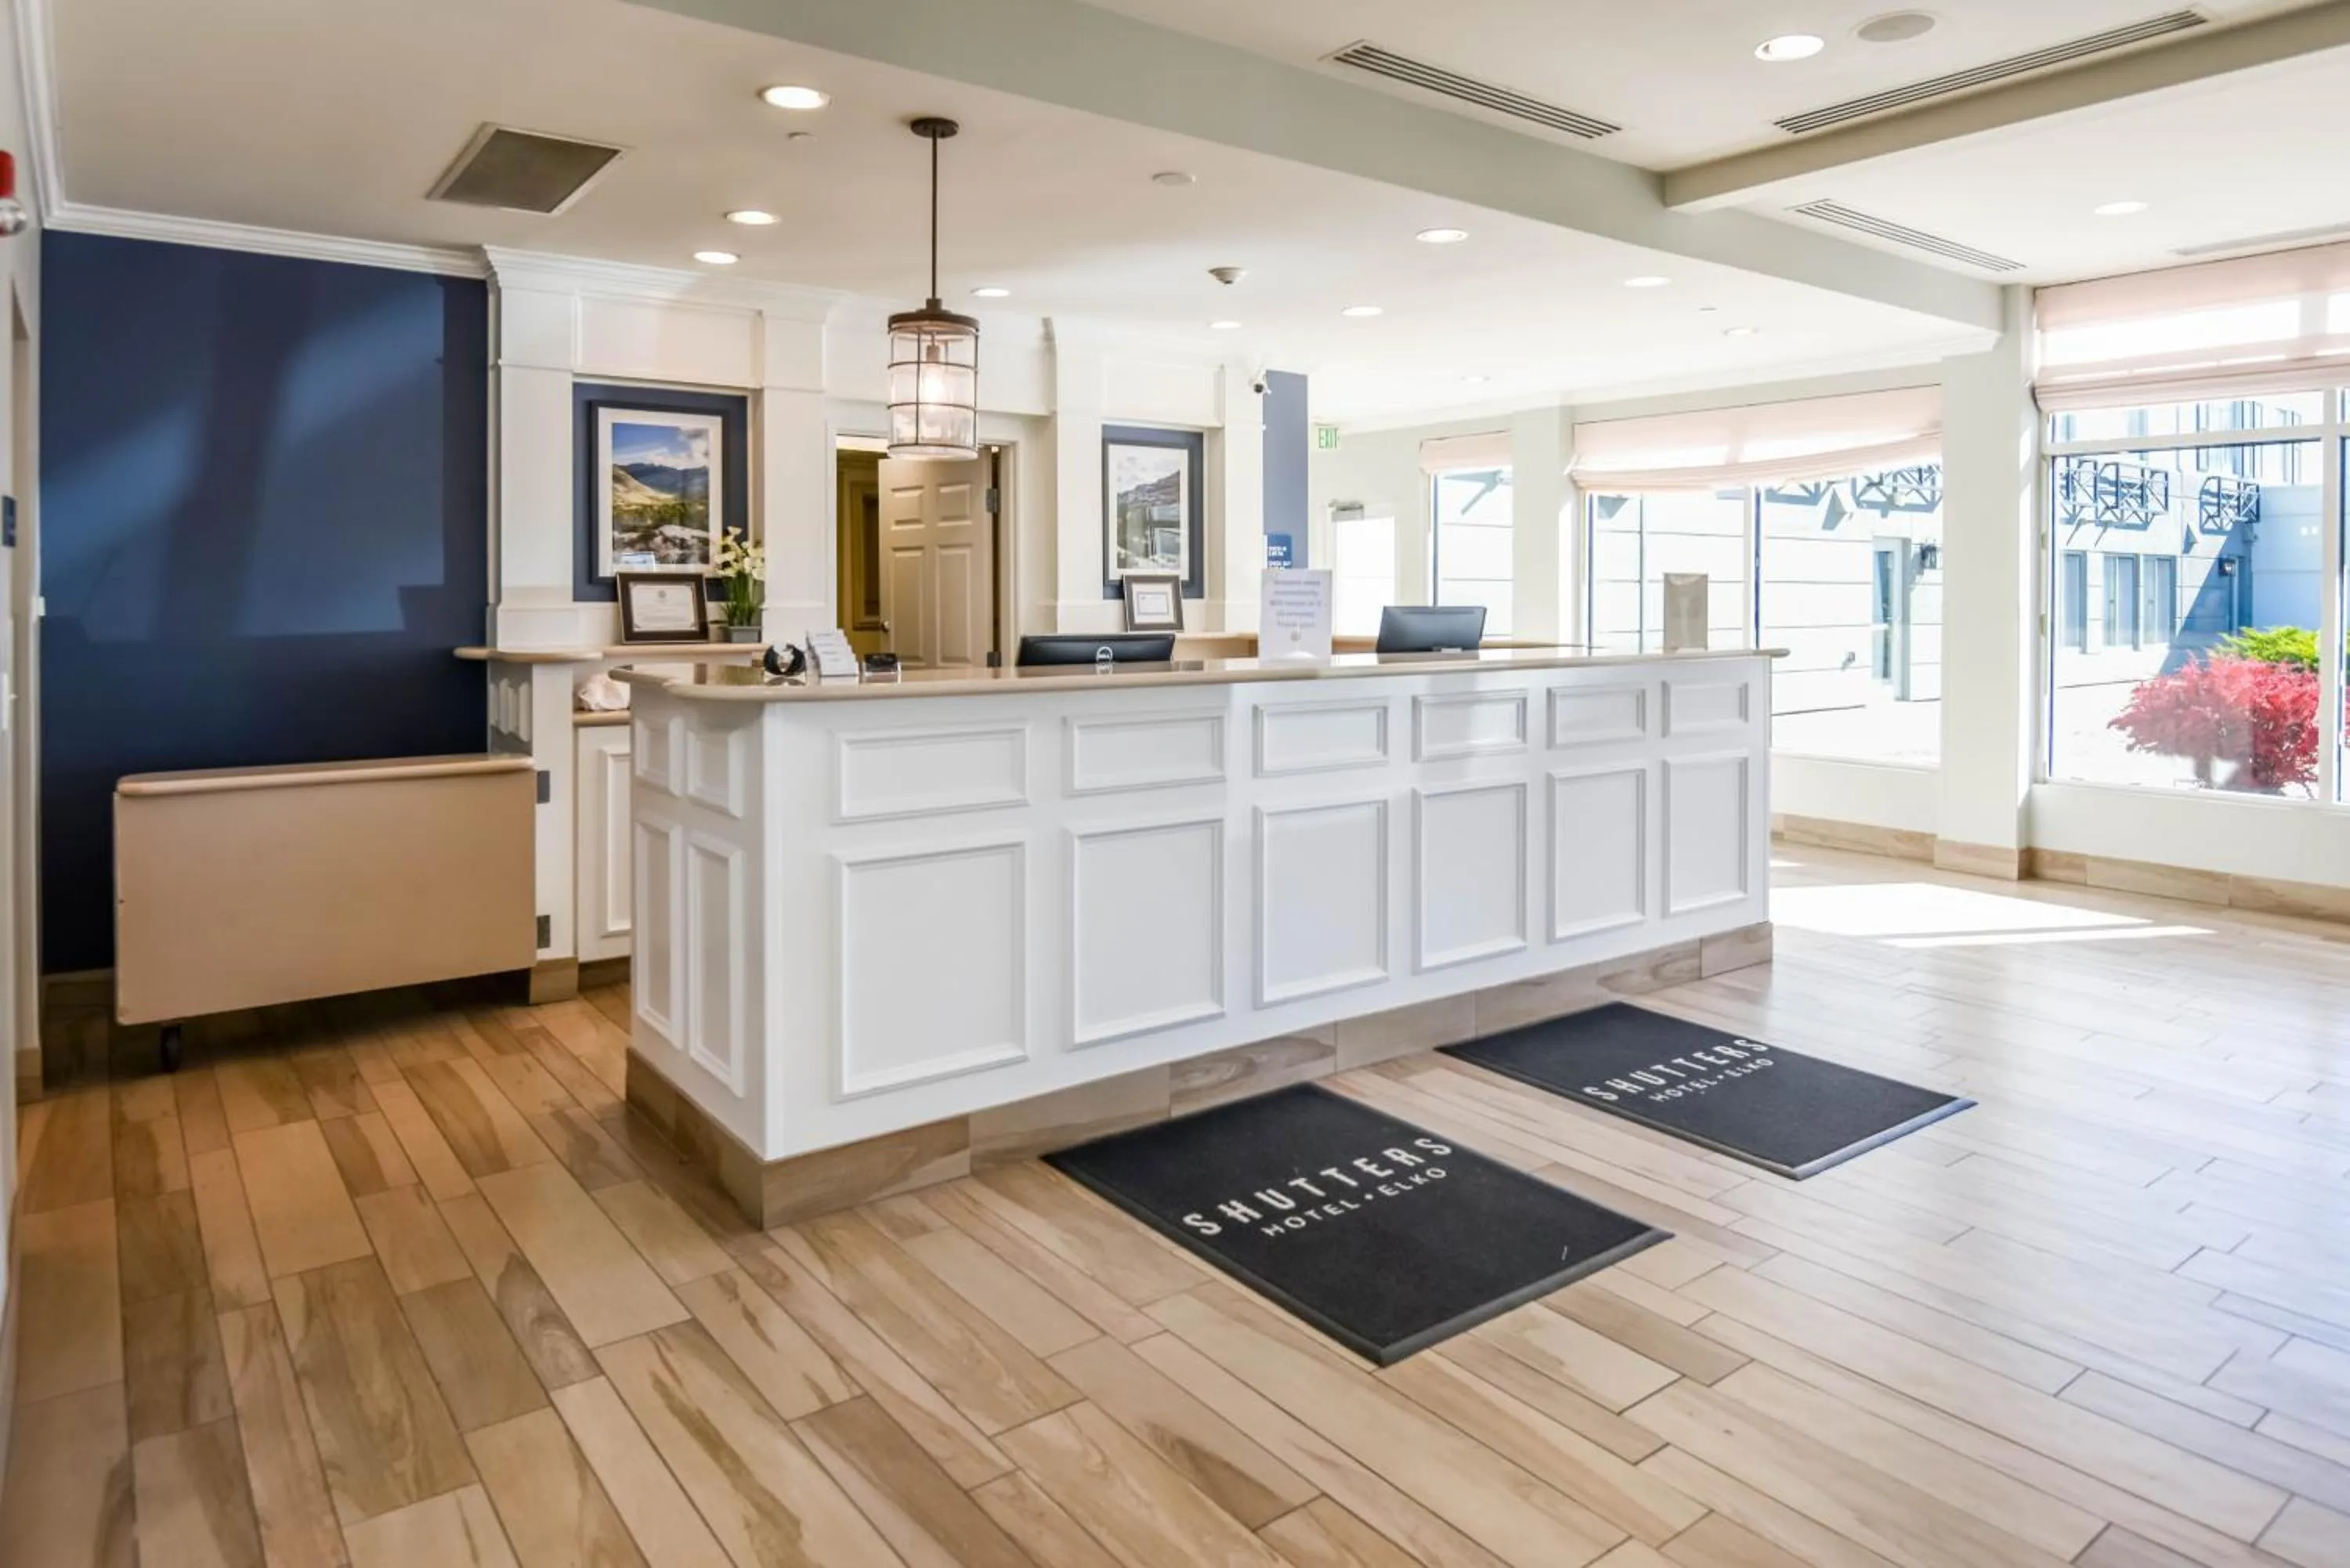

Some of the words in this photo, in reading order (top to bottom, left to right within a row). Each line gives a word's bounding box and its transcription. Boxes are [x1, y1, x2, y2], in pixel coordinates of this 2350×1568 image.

[1318, 428, 1338, 449] EXIT
[1582, 1039, 1769, 1101] SHUTTERS
[1648, 1078, 1718, 1103] HOTEL
[1183, 1137, 1453, 1236] SHUTTERS
[1261, 1199, 1361, 1237] HOTEL
[1377, 1167, 1448, 1197] ELKO
